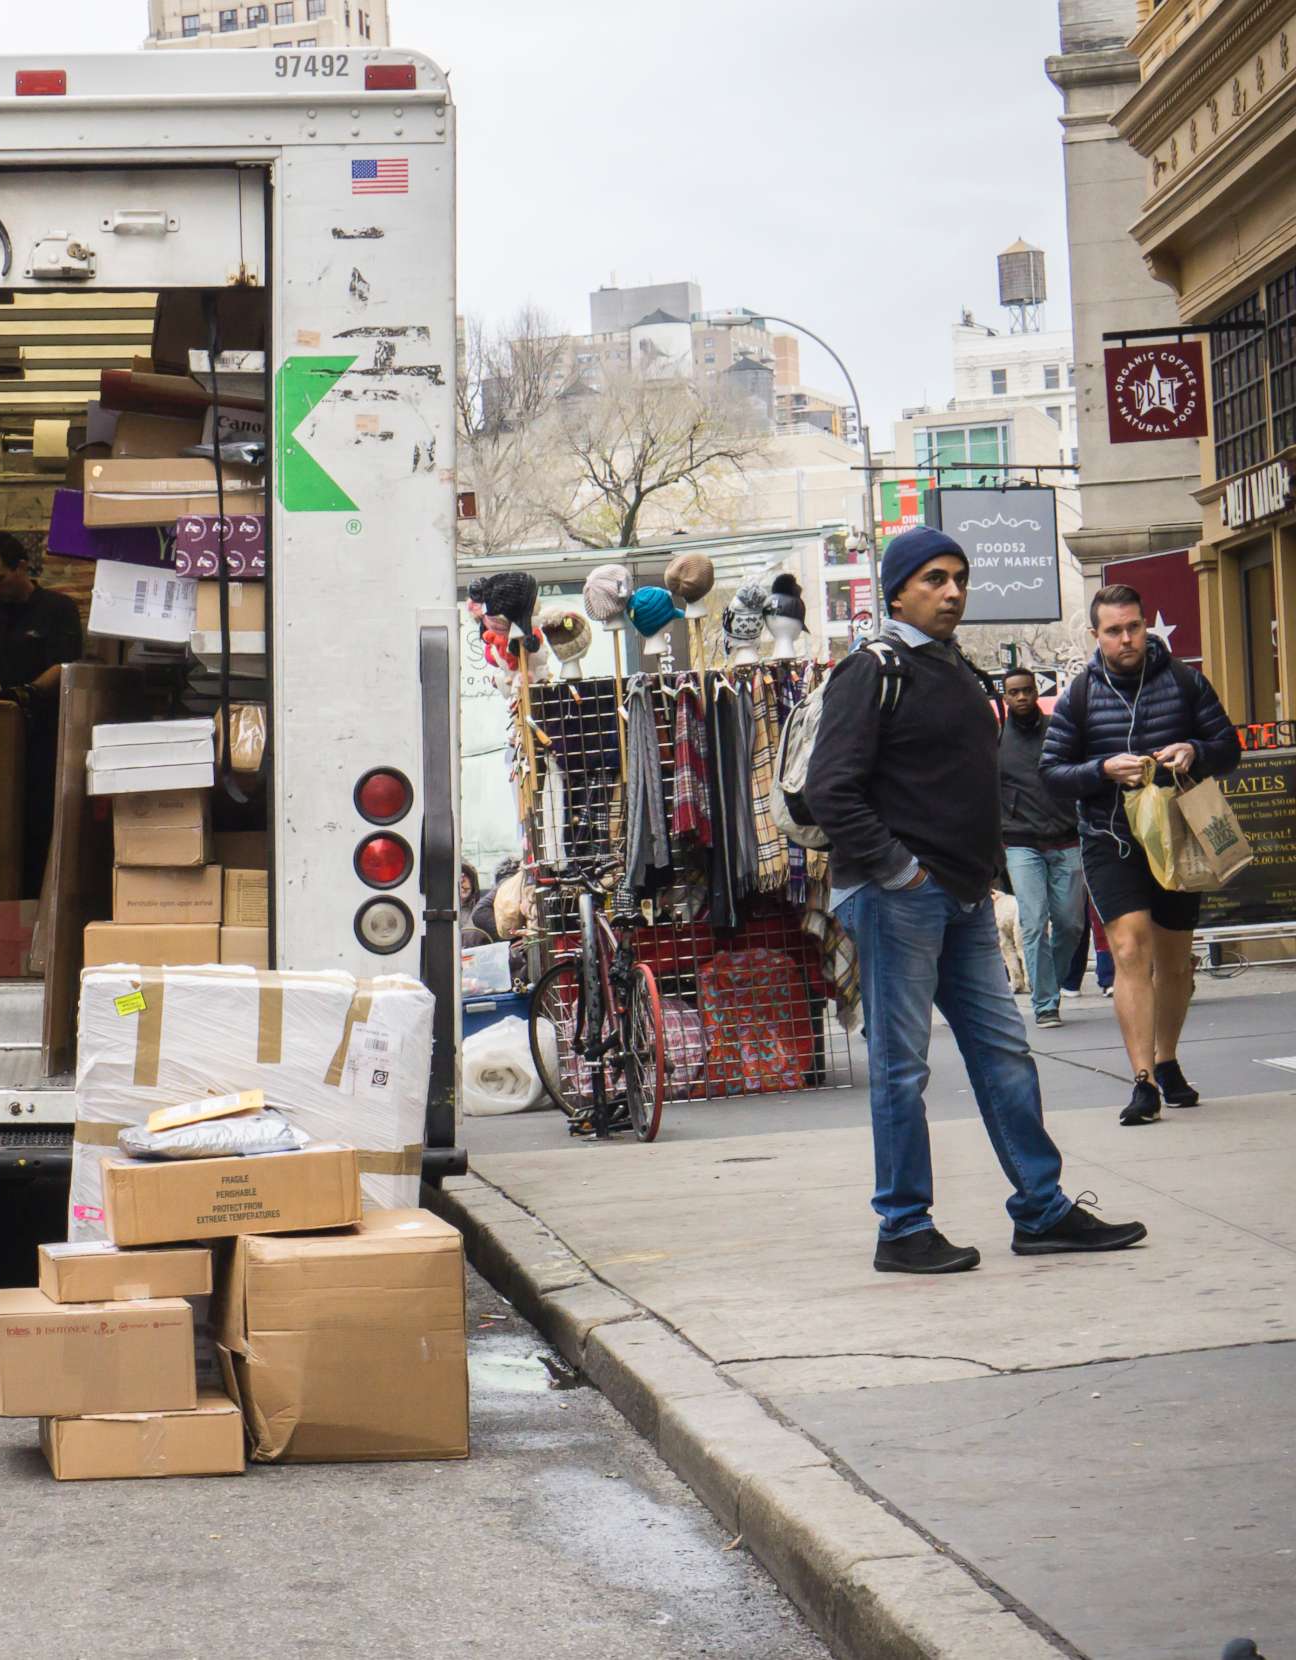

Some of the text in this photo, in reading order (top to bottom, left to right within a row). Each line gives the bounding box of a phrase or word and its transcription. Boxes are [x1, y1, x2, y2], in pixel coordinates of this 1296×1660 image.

[275, 54, 350, 78] 97492
[1114, 351, 1197, 393] ORGANIC COFFEE
[1134, 377, 1179, 410] PRET
[1119, 399, 1196, 434] NATURAL FOOD
[976, 542, 1026, 554] FOOD52
[1004, 556, 1053, 568] MARKET
[221, 1174, 249, 1185] FRAGILE
[215, 1187, 257, 1199] PERISHABLE
[212, 1201, 263, 1214] PROTECT FROM
[196, 1209, 281, 1225] EXTREME TEMPERATURES
